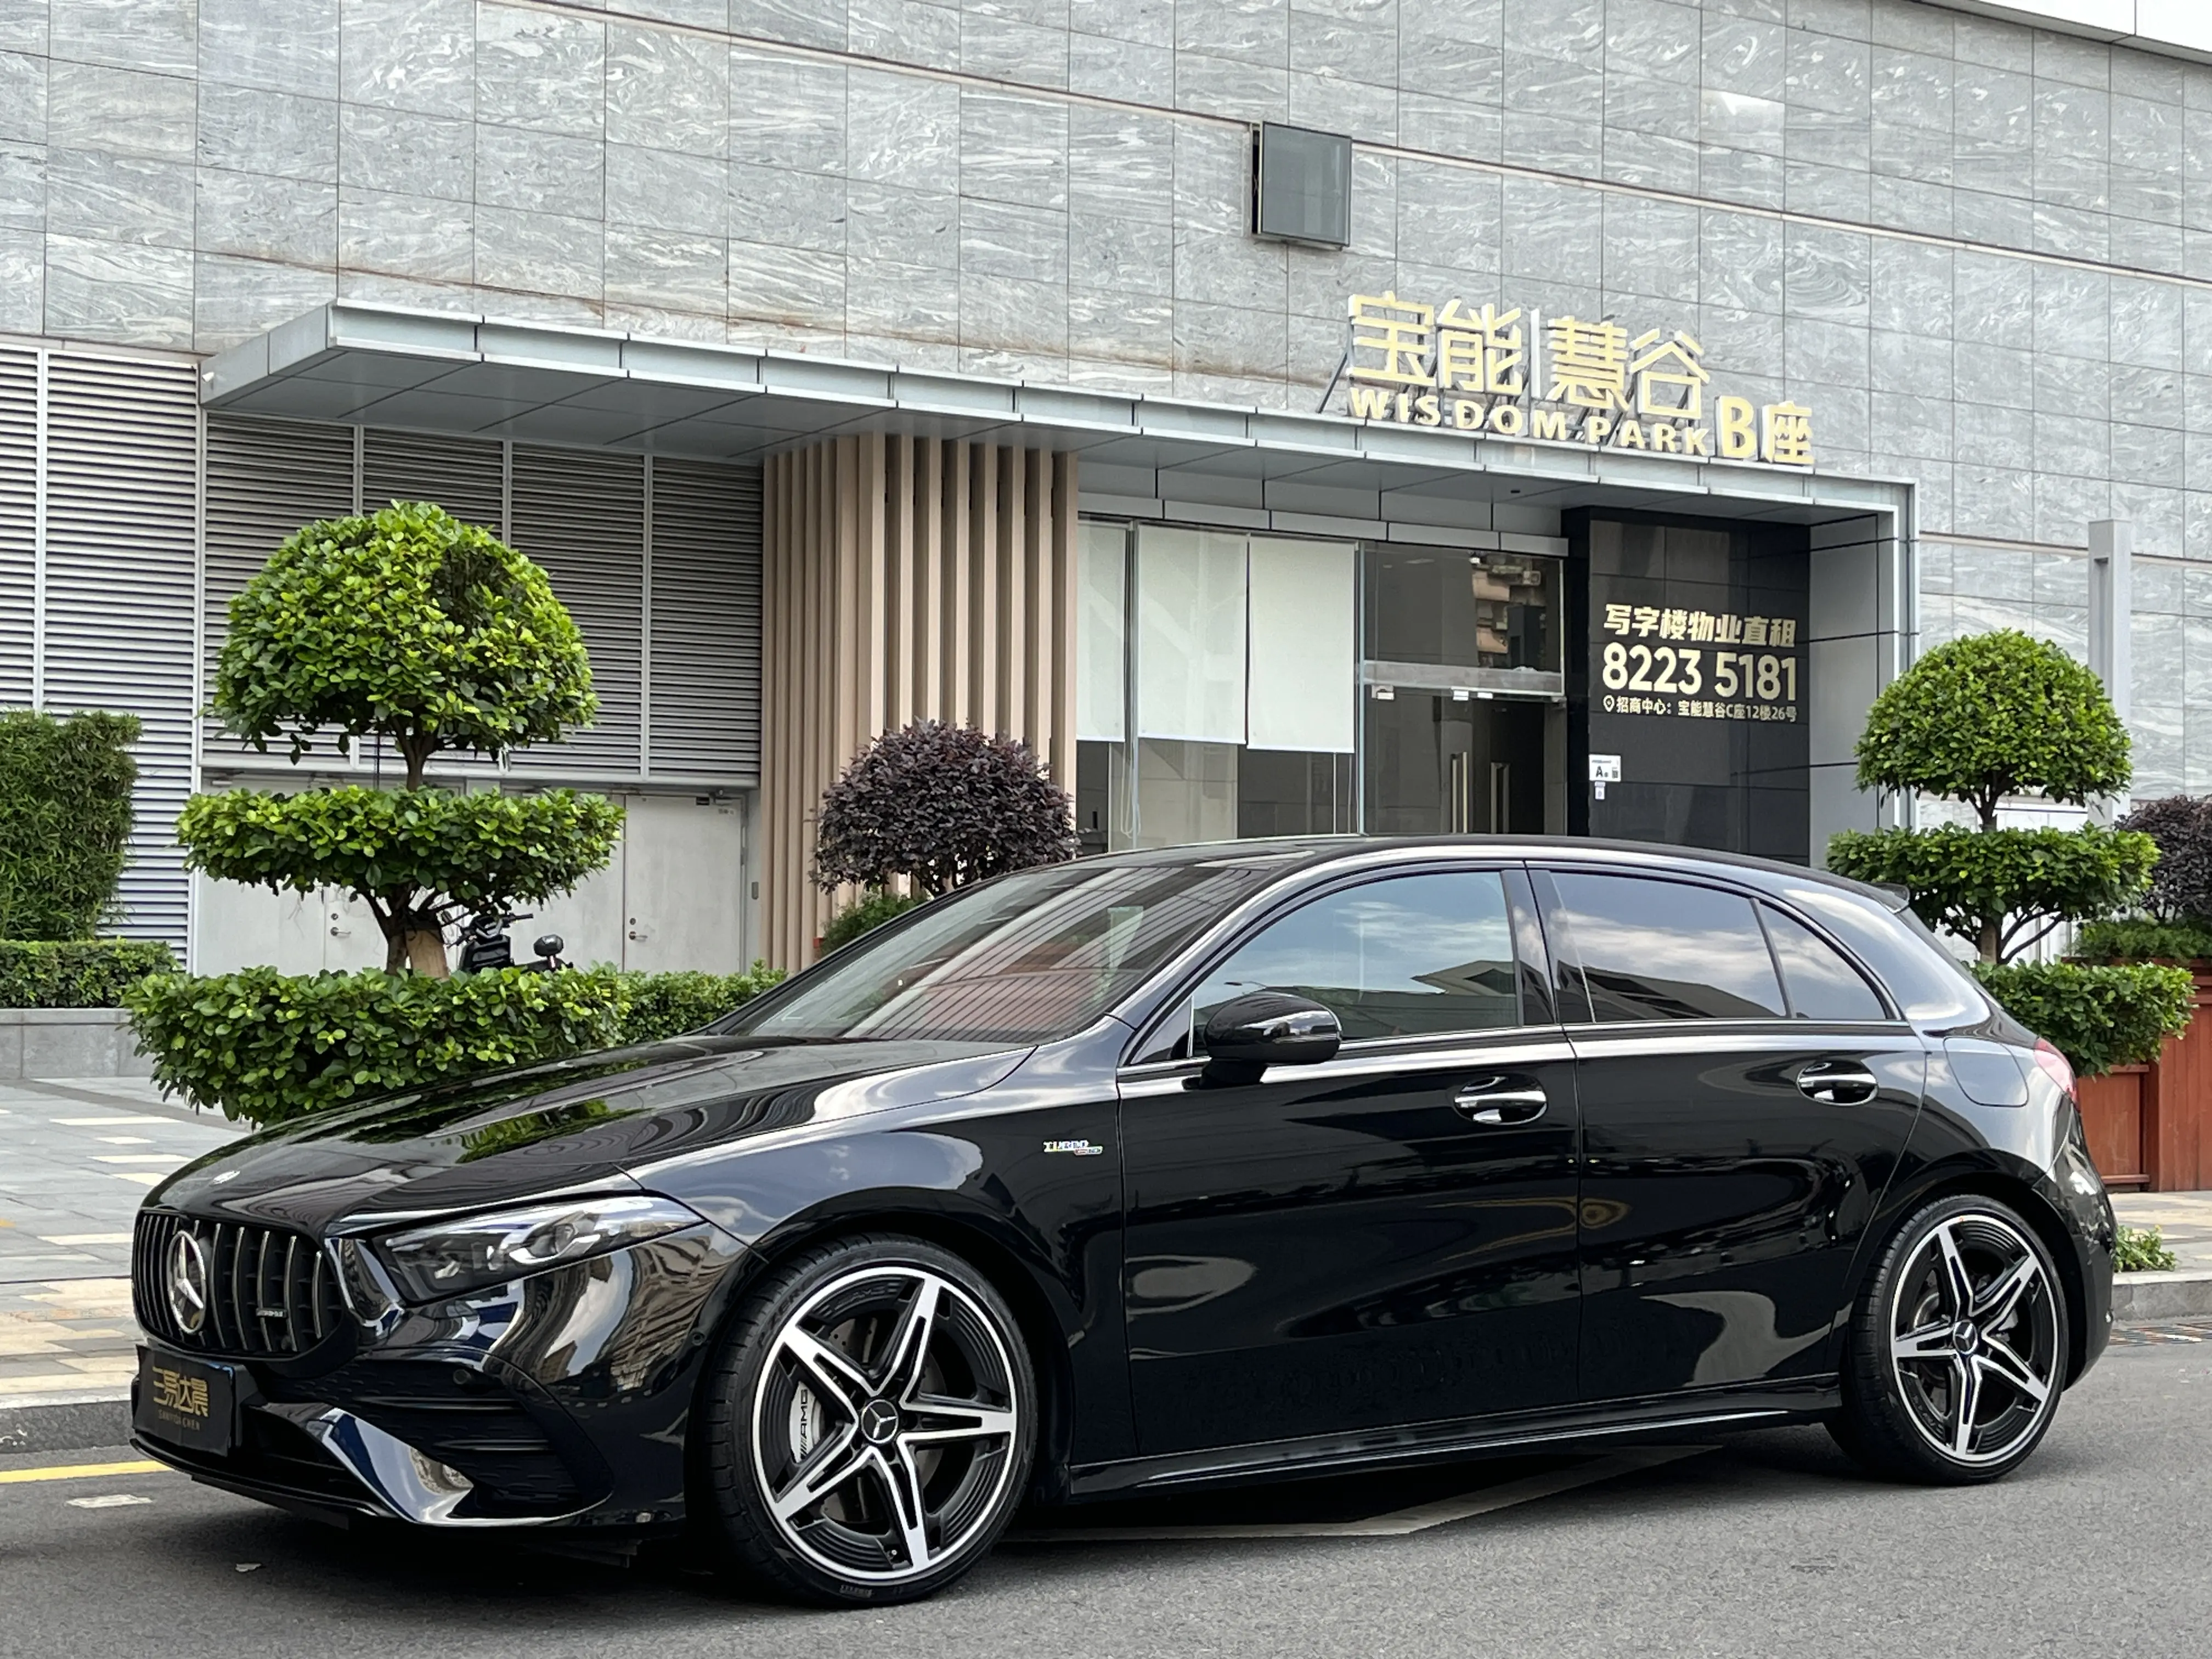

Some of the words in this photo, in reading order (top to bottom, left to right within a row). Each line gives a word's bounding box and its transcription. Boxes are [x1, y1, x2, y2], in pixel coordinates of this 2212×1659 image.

[1346, 290, 1522, 396] 宝能
[1545, 315, 1711, 420] 慧谷
[1347, 387, 1567, 441] WISDOM
[1587, 415, 1710, 456] PARK
[1715, 395, 1815, 465] B座
[1604, 603, 1797, 648] 写字楼物业直租
[1602, 641, 1702, 696] 8223
[1714, 651, 1797, 701] 5181
